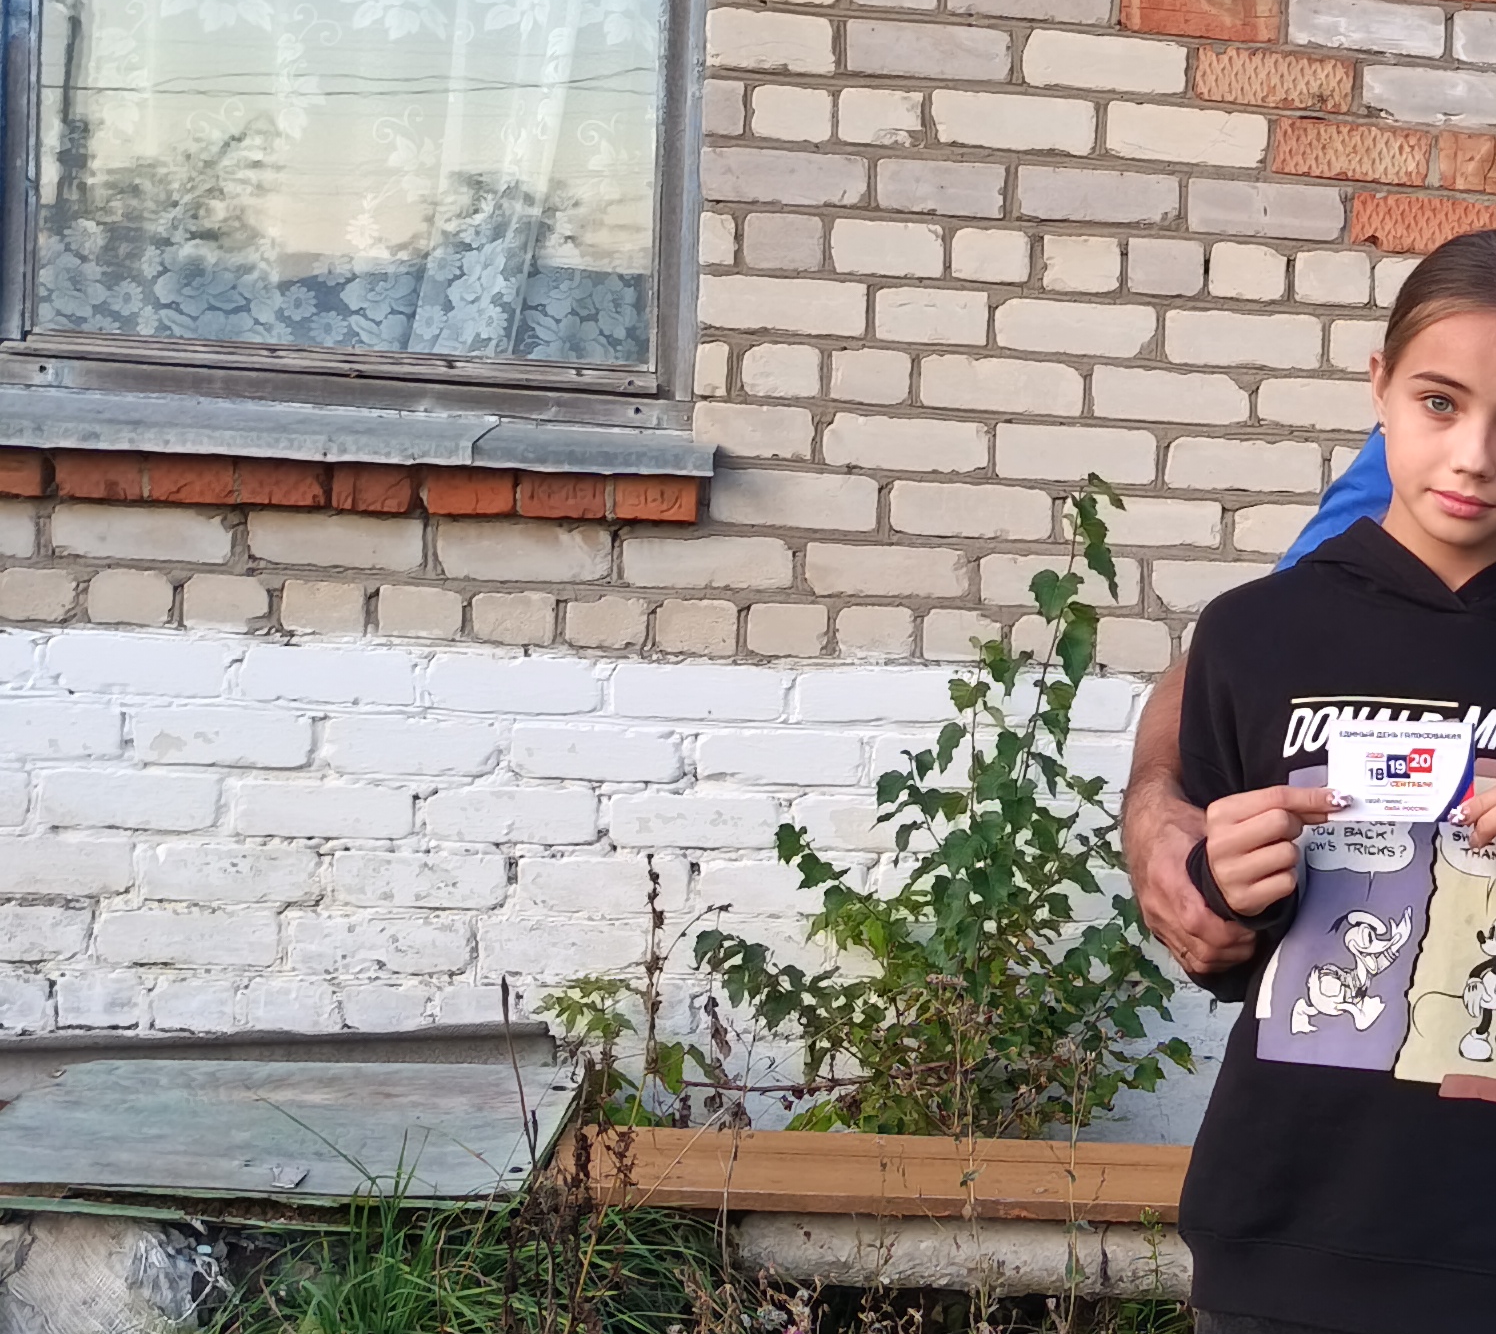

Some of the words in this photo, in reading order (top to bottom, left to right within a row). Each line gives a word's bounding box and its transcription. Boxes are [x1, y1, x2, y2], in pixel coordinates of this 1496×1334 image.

[1388, 759, 1407, 775] 19
[1409, 753, 1432, 768] 20
[1367, 767, 1385, 781] 18
[1311, 826, 1336, 836] YOU
